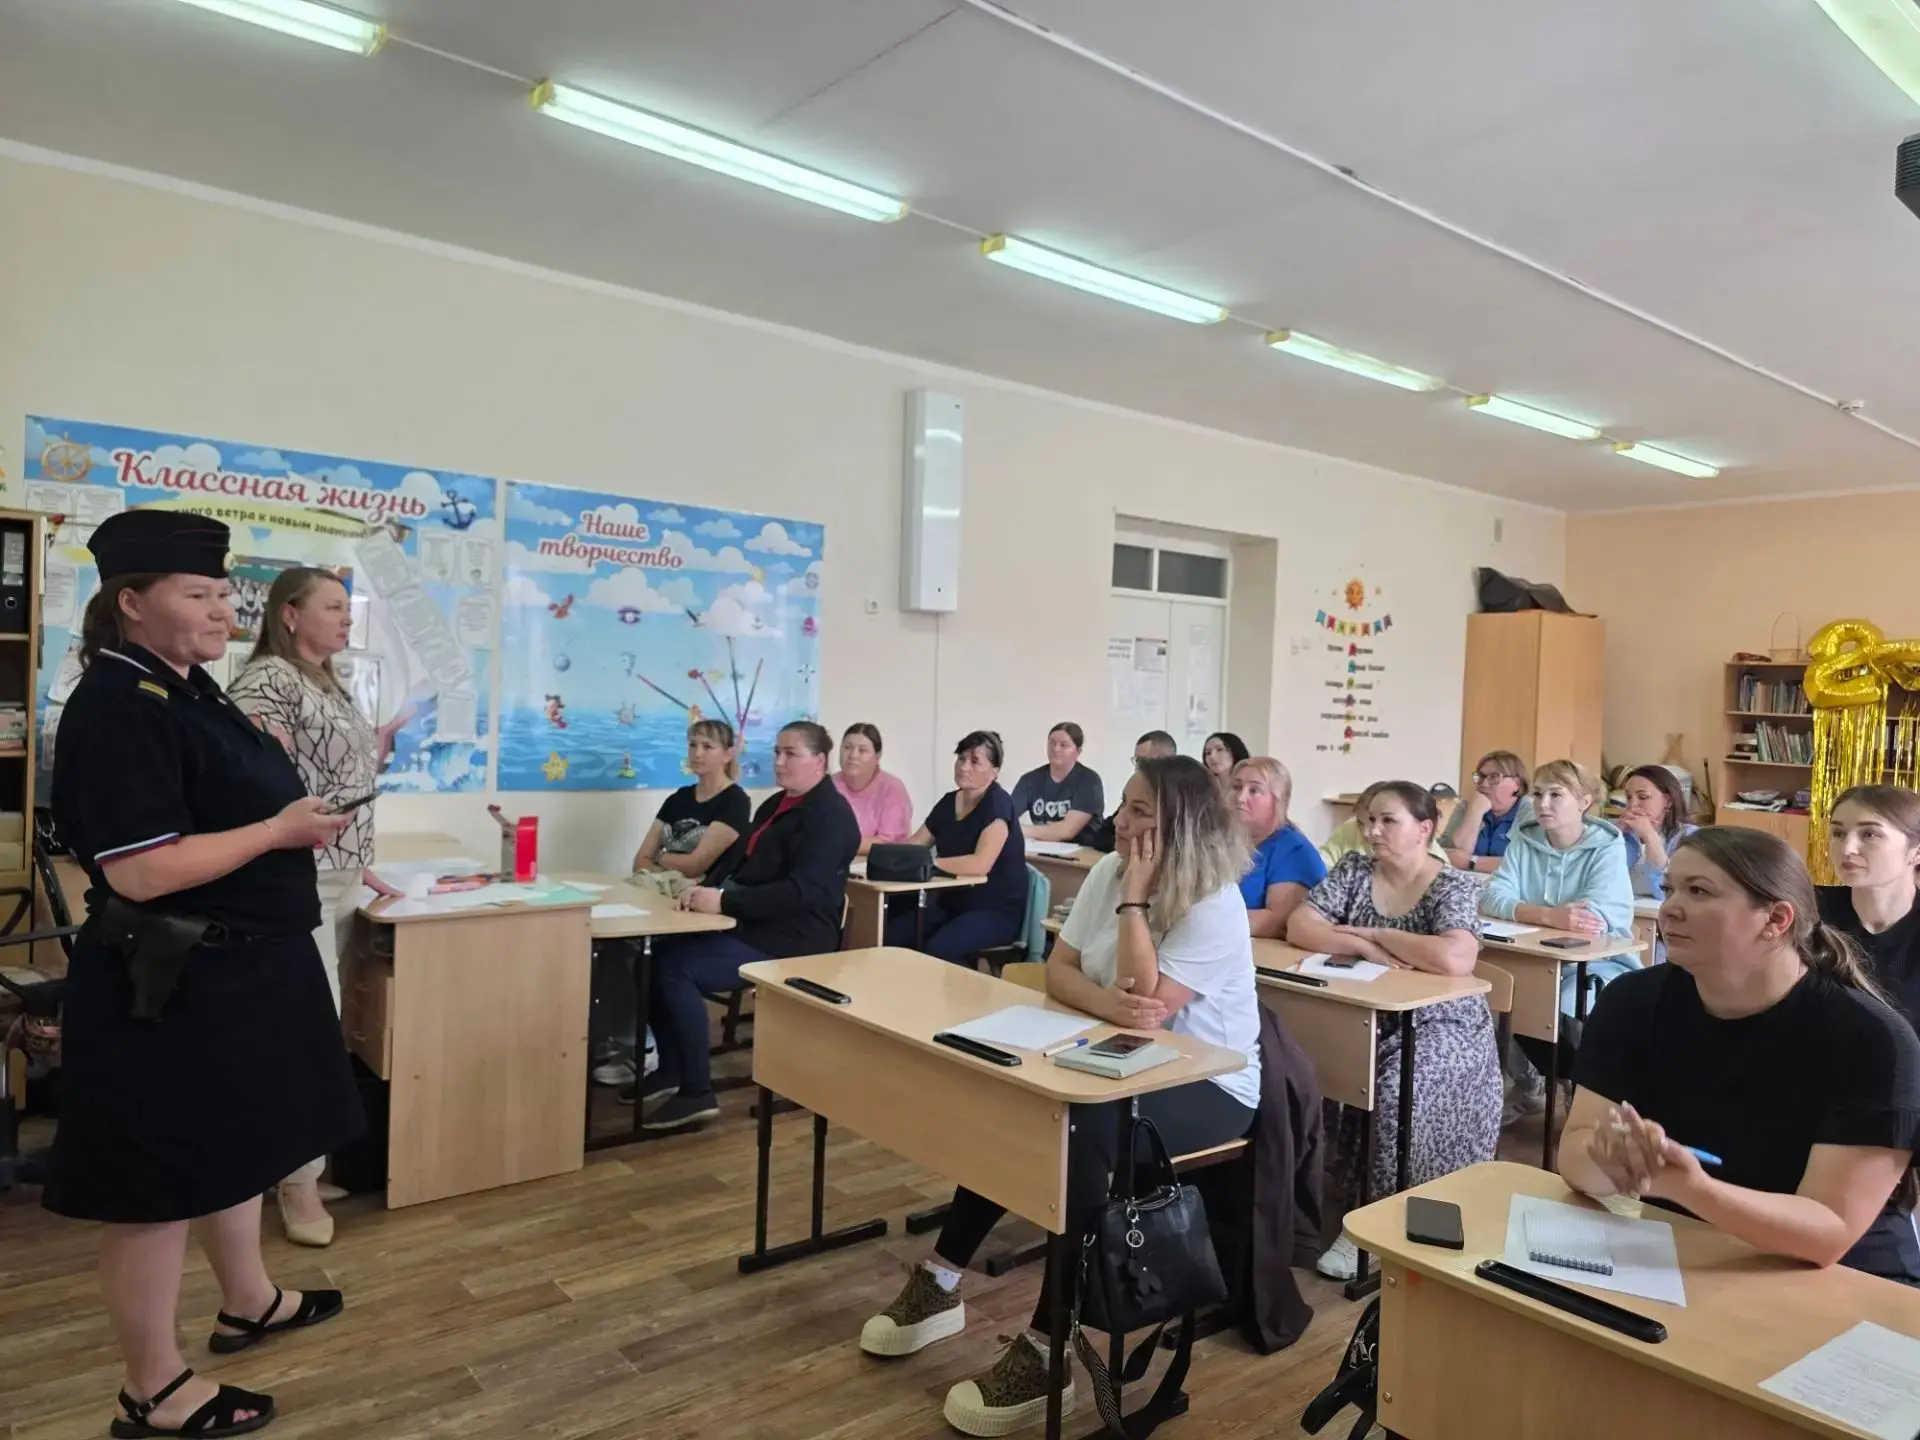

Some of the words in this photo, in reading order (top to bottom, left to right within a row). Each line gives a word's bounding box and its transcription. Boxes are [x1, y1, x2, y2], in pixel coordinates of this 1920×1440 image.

[114, 452, 309, 503] Классная
[316, 486, 426, 519] жизнь
[216, 507, 255, 522] ветра
[258, 513, 266, 521] к
[270, 515, 311, 529] новым
[582, 512, 647, 540] Наше
[540, 535, 683, 568] творчество
